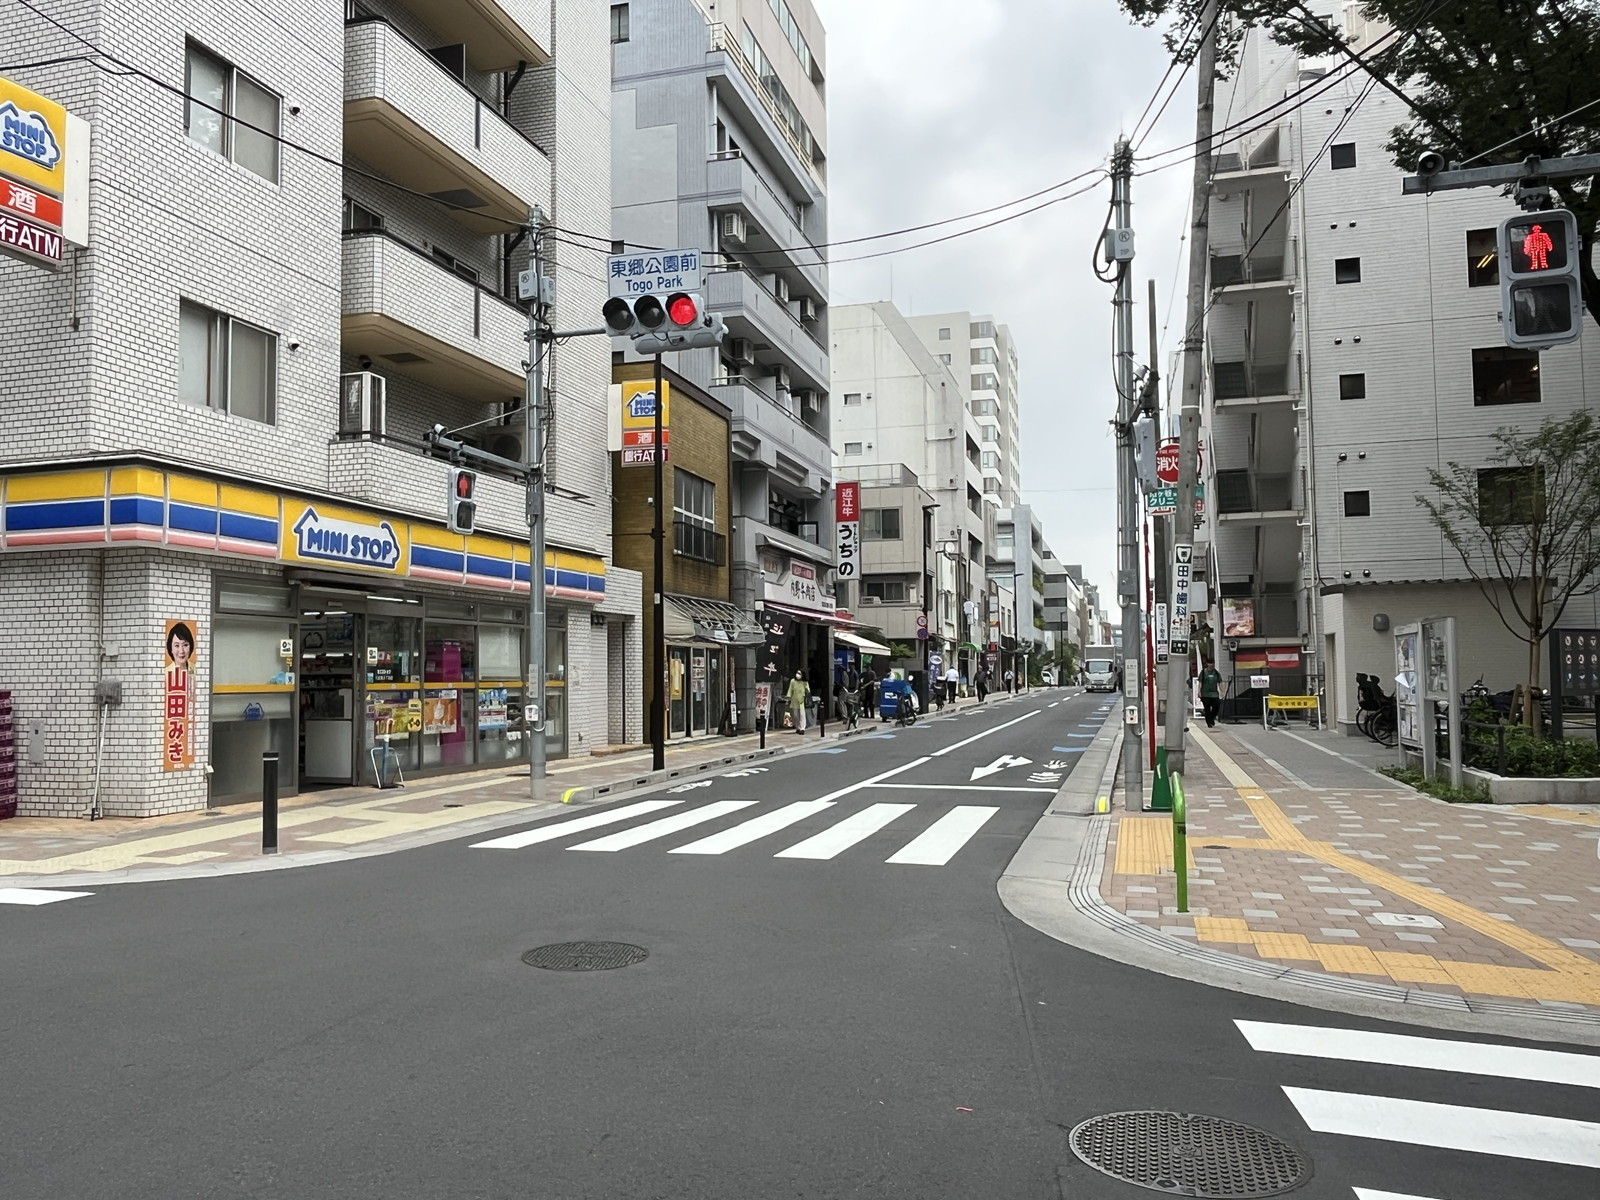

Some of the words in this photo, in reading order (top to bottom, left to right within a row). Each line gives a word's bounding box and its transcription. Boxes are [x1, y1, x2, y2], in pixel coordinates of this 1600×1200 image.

[4, 115, 46, 143] MINI
[3, 131, 47, 158] STOP
[8, 184, 38, 214] 酒
[610, 253, 697, 278] 東郷公園前
[625, 279, 653, 293] Togo
[657, 275, 683, 289] Park
[1157, 456, 1179, 471] 消火
[842, 487, 854, 517] 近江牛
[307, 527, 349, 555] MINI
[350, 535, 393, 561] STOP
[838, 524, 854, 576] うちの
[1175, 565, 1189, 618] 田中歯科
[167, 666, 187, 762] 山田みき
